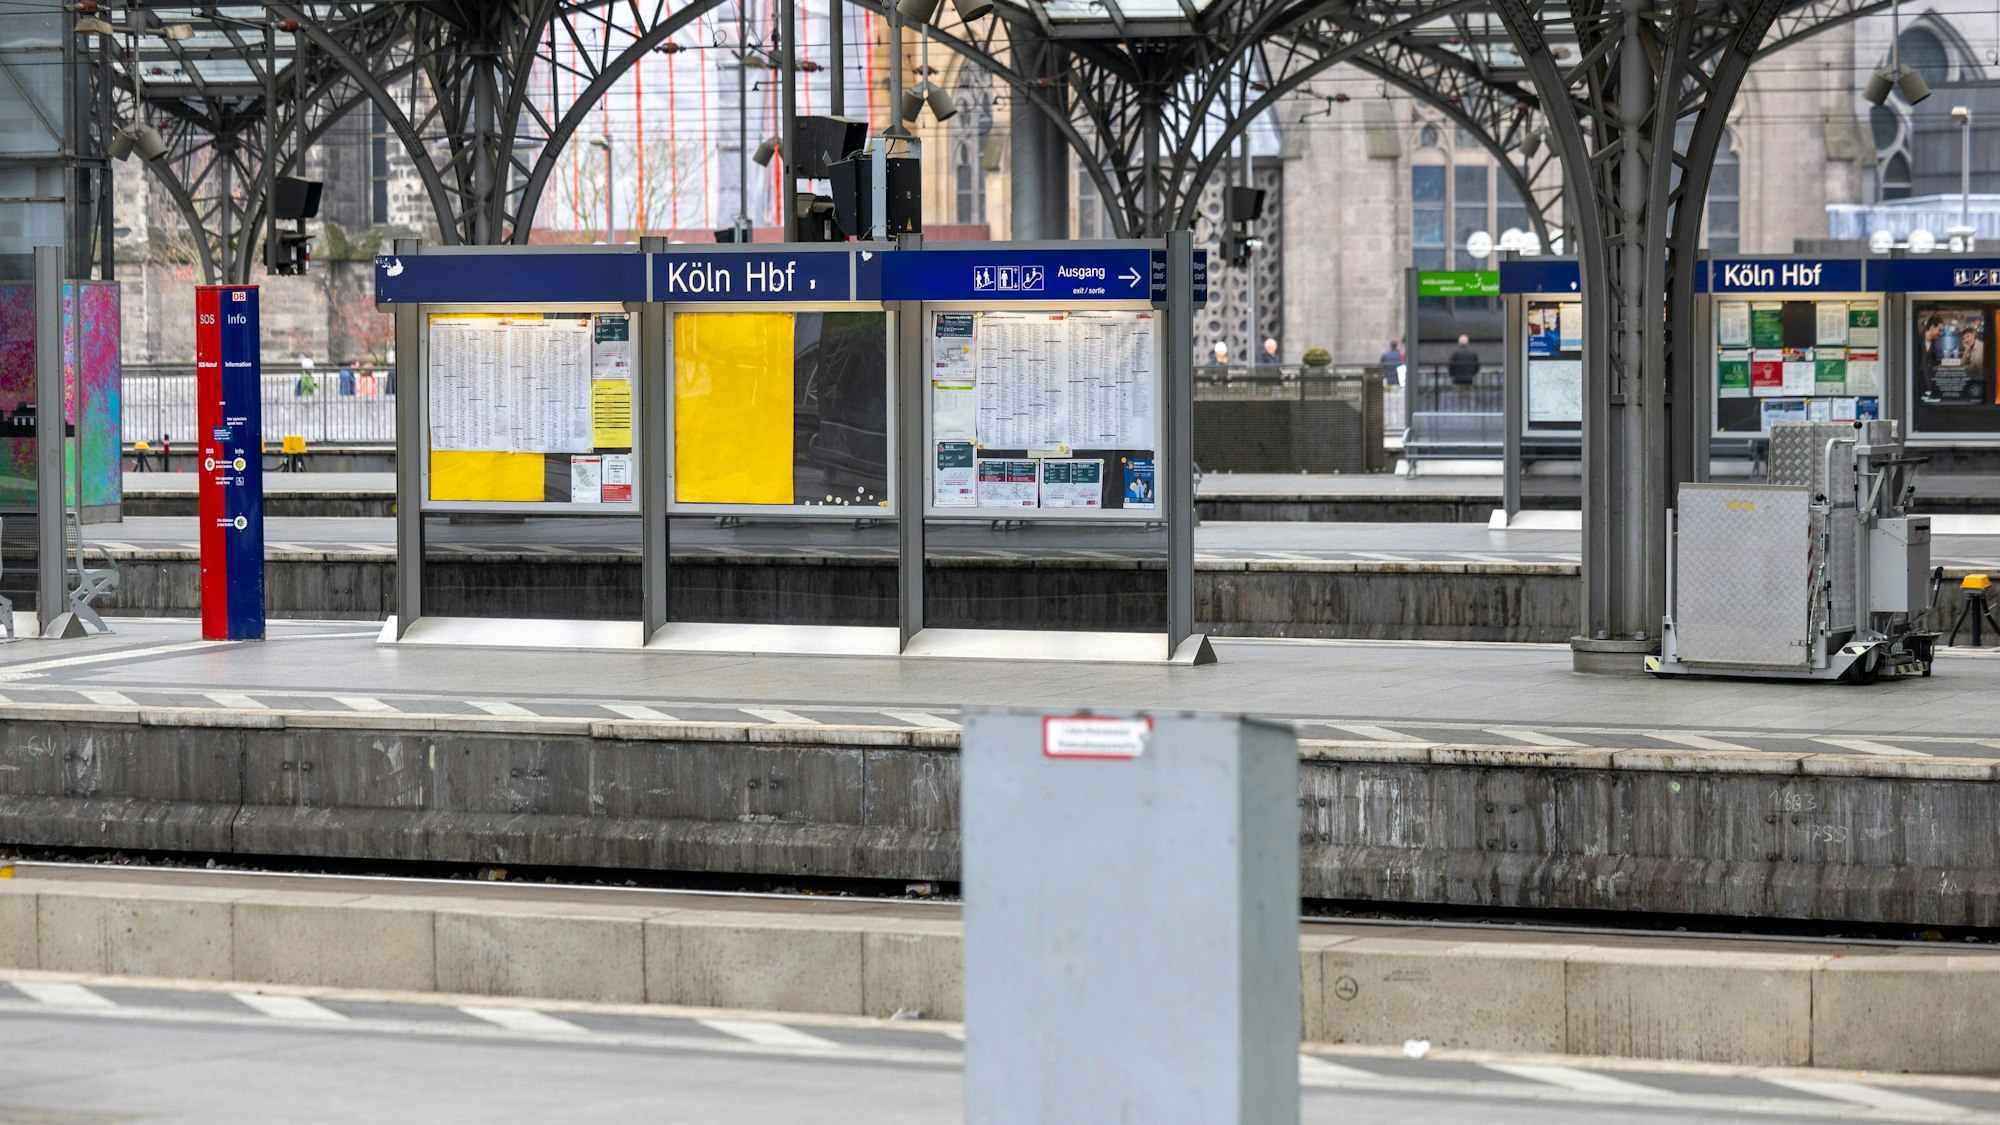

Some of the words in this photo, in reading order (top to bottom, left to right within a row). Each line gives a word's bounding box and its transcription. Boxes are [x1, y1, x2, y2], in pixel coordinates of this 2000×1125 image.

[668, 262, 731, 293] Köln
[746, 261, 797, 292] Hbf
[1057, 265, 1106, 279] Ausgang
[1724, 264, 1774, 286] Köln
[1782, 263, 1822, 286] Hbf
[233, 292, 246, 301] DB
[200, 314, 215, 324] SOS
[227, 314, 247, 324] Info
